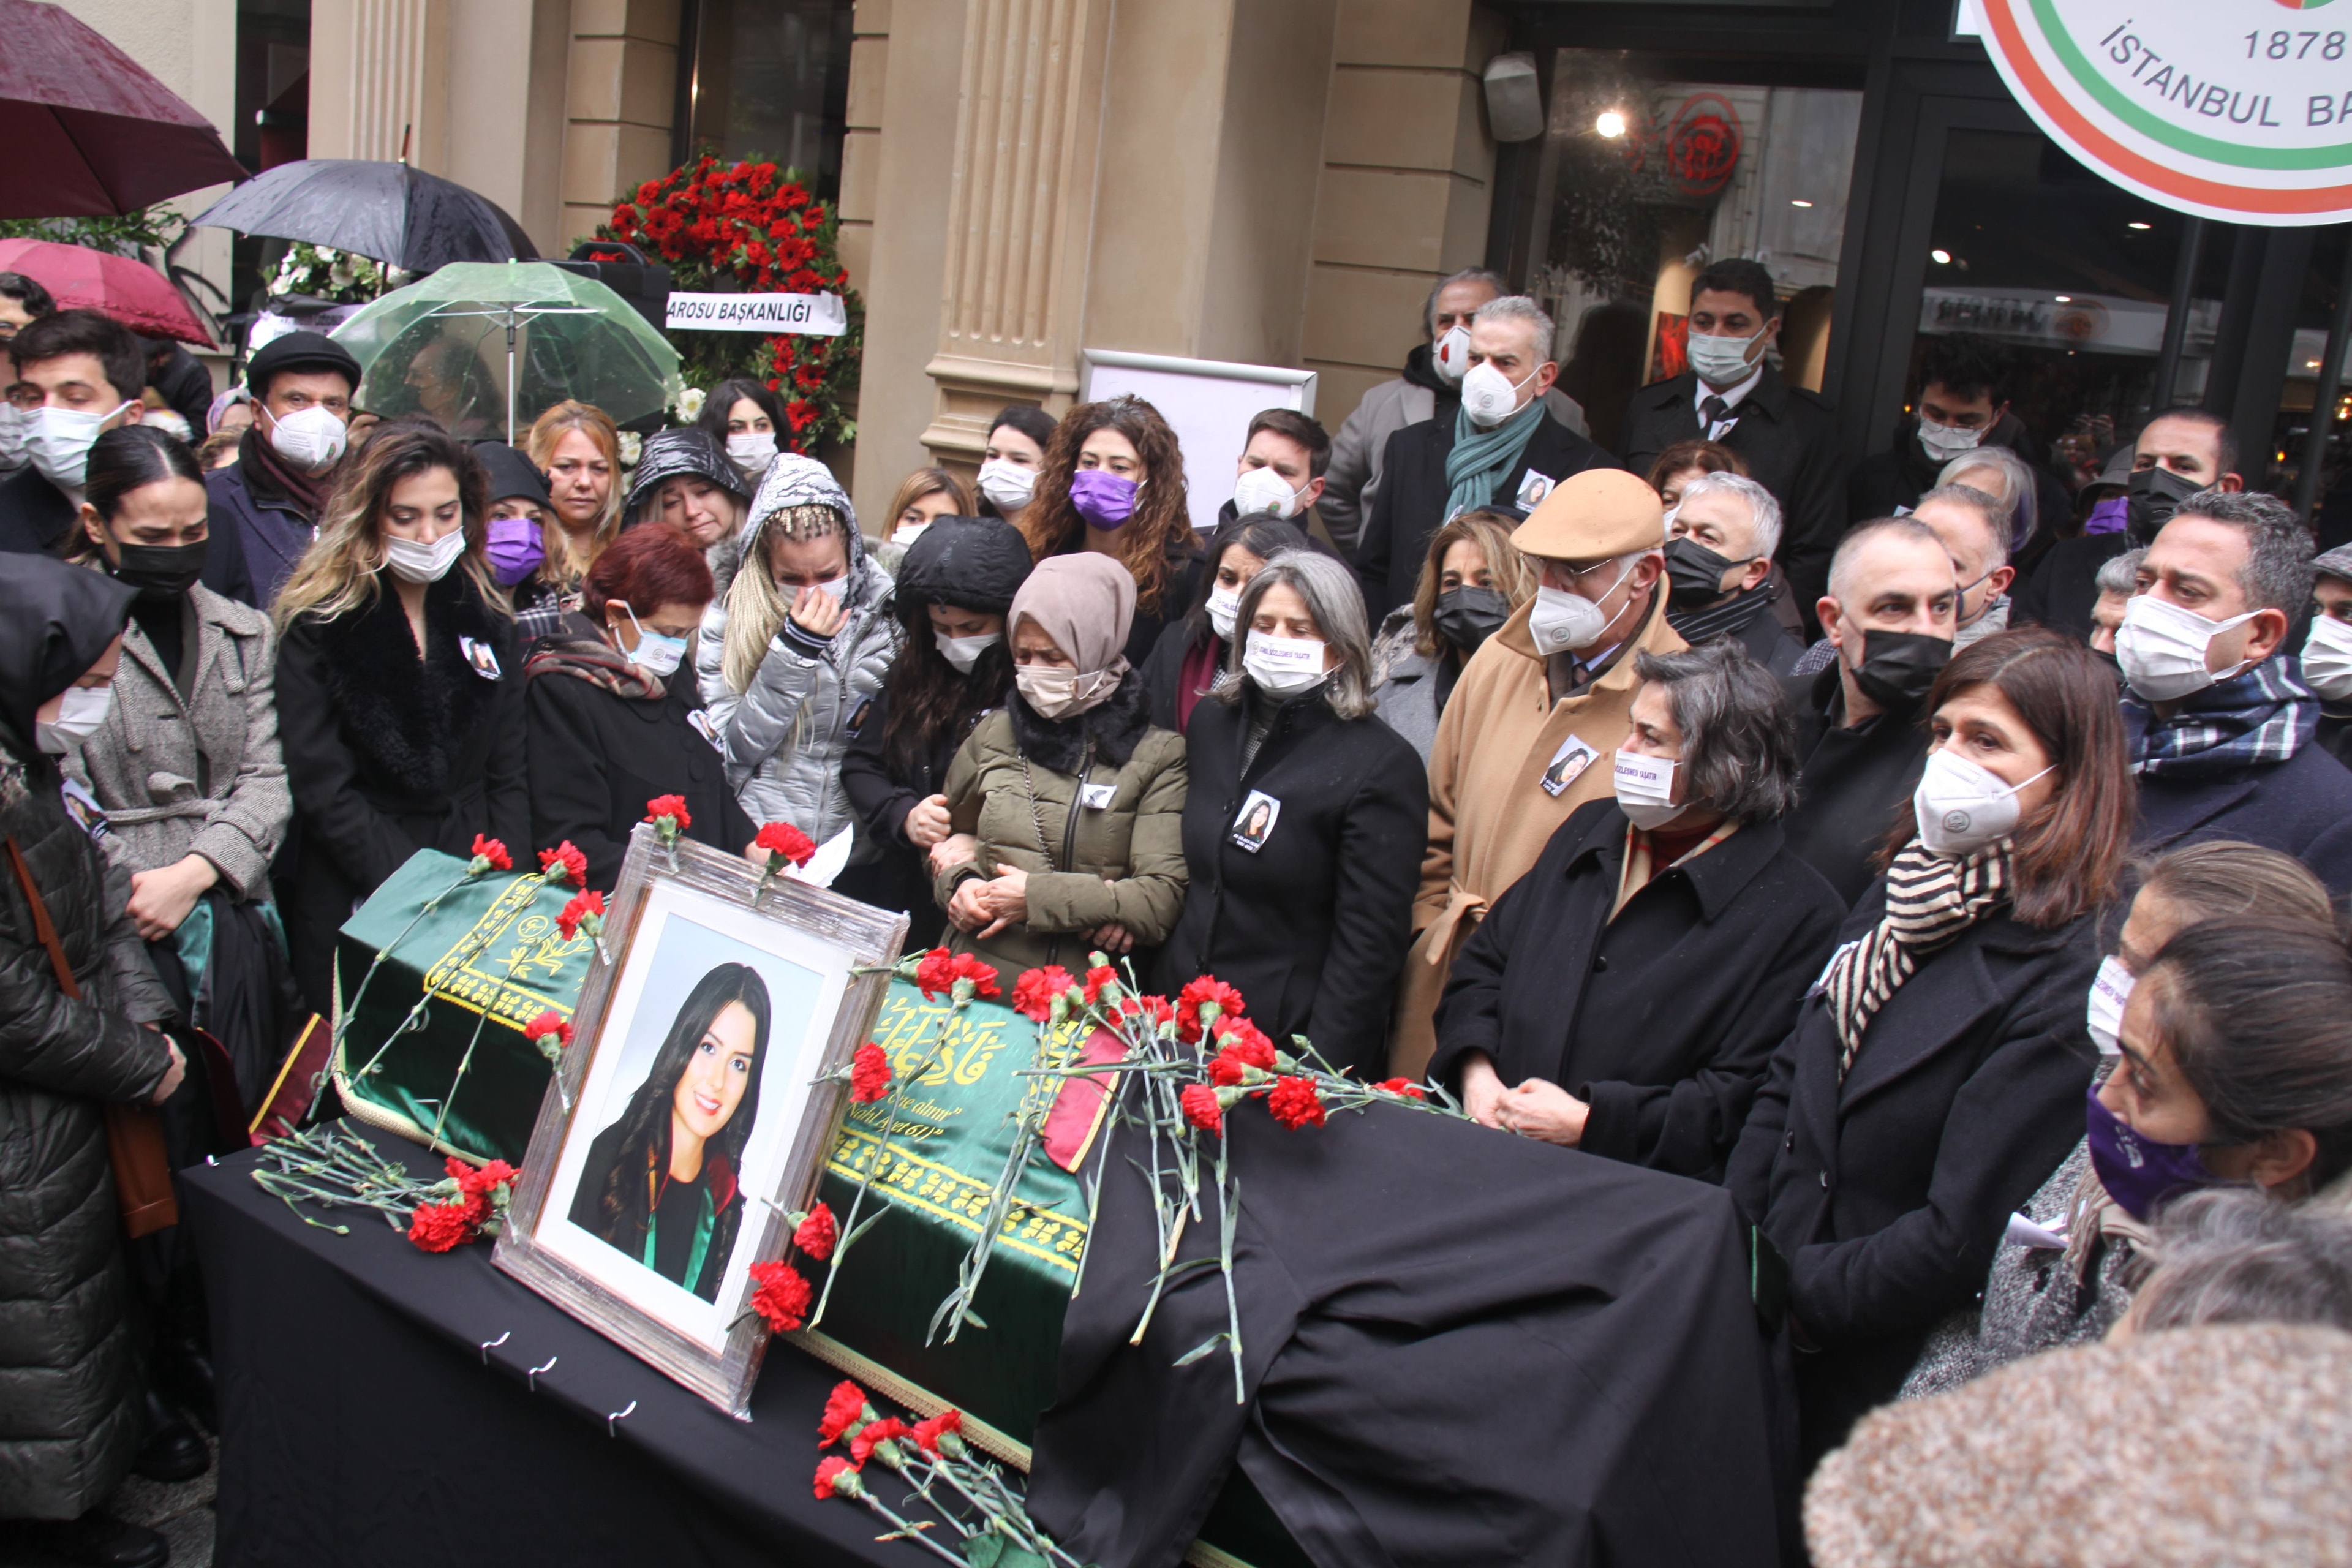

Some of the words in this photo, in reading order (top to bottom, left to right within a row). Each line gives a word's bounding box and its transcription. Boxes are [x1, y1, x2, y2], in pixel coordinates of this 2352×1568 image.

[2244, 31, 2345, 61] 1878
[2100, 18, 2280, 127] İSTANBUL
[718, 300, 812, 325] BAŞKANLIĞI
